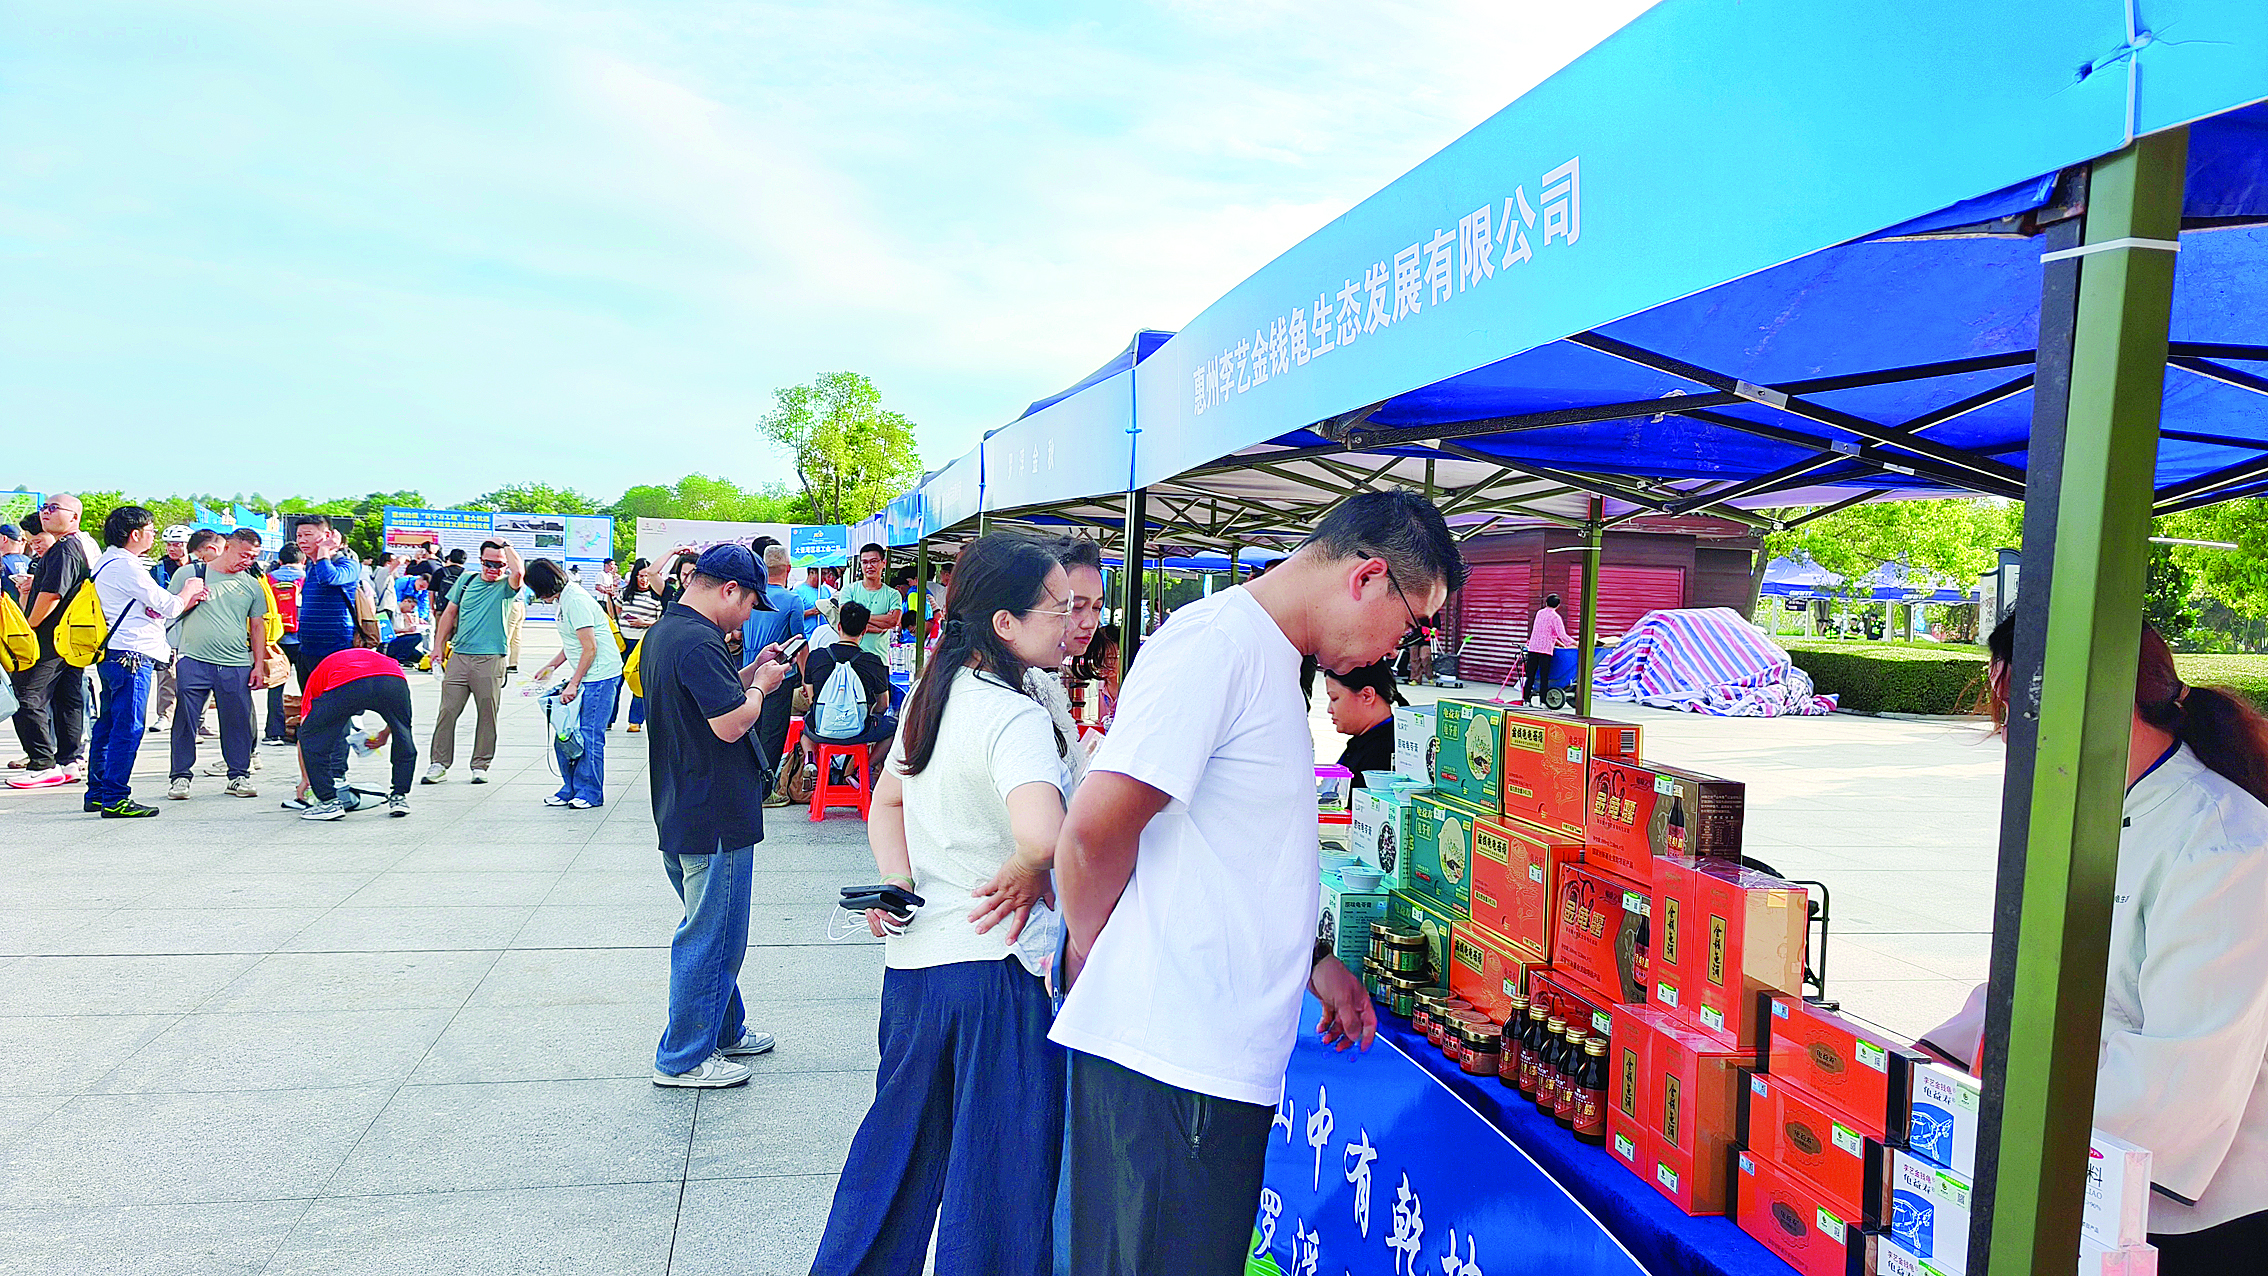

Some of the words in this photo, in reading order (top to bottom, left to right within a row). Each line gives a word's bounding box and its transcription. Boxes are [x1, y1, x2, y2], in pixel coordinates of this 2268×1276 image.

[1192, 155, 1581, 416] 惠州李艺金钱龟生态发展有限公司
[1923, 1076, 1953, 1095] 李艺金钱龟
[1903, 1164, 1932, 1184] 李艺金钱龟
